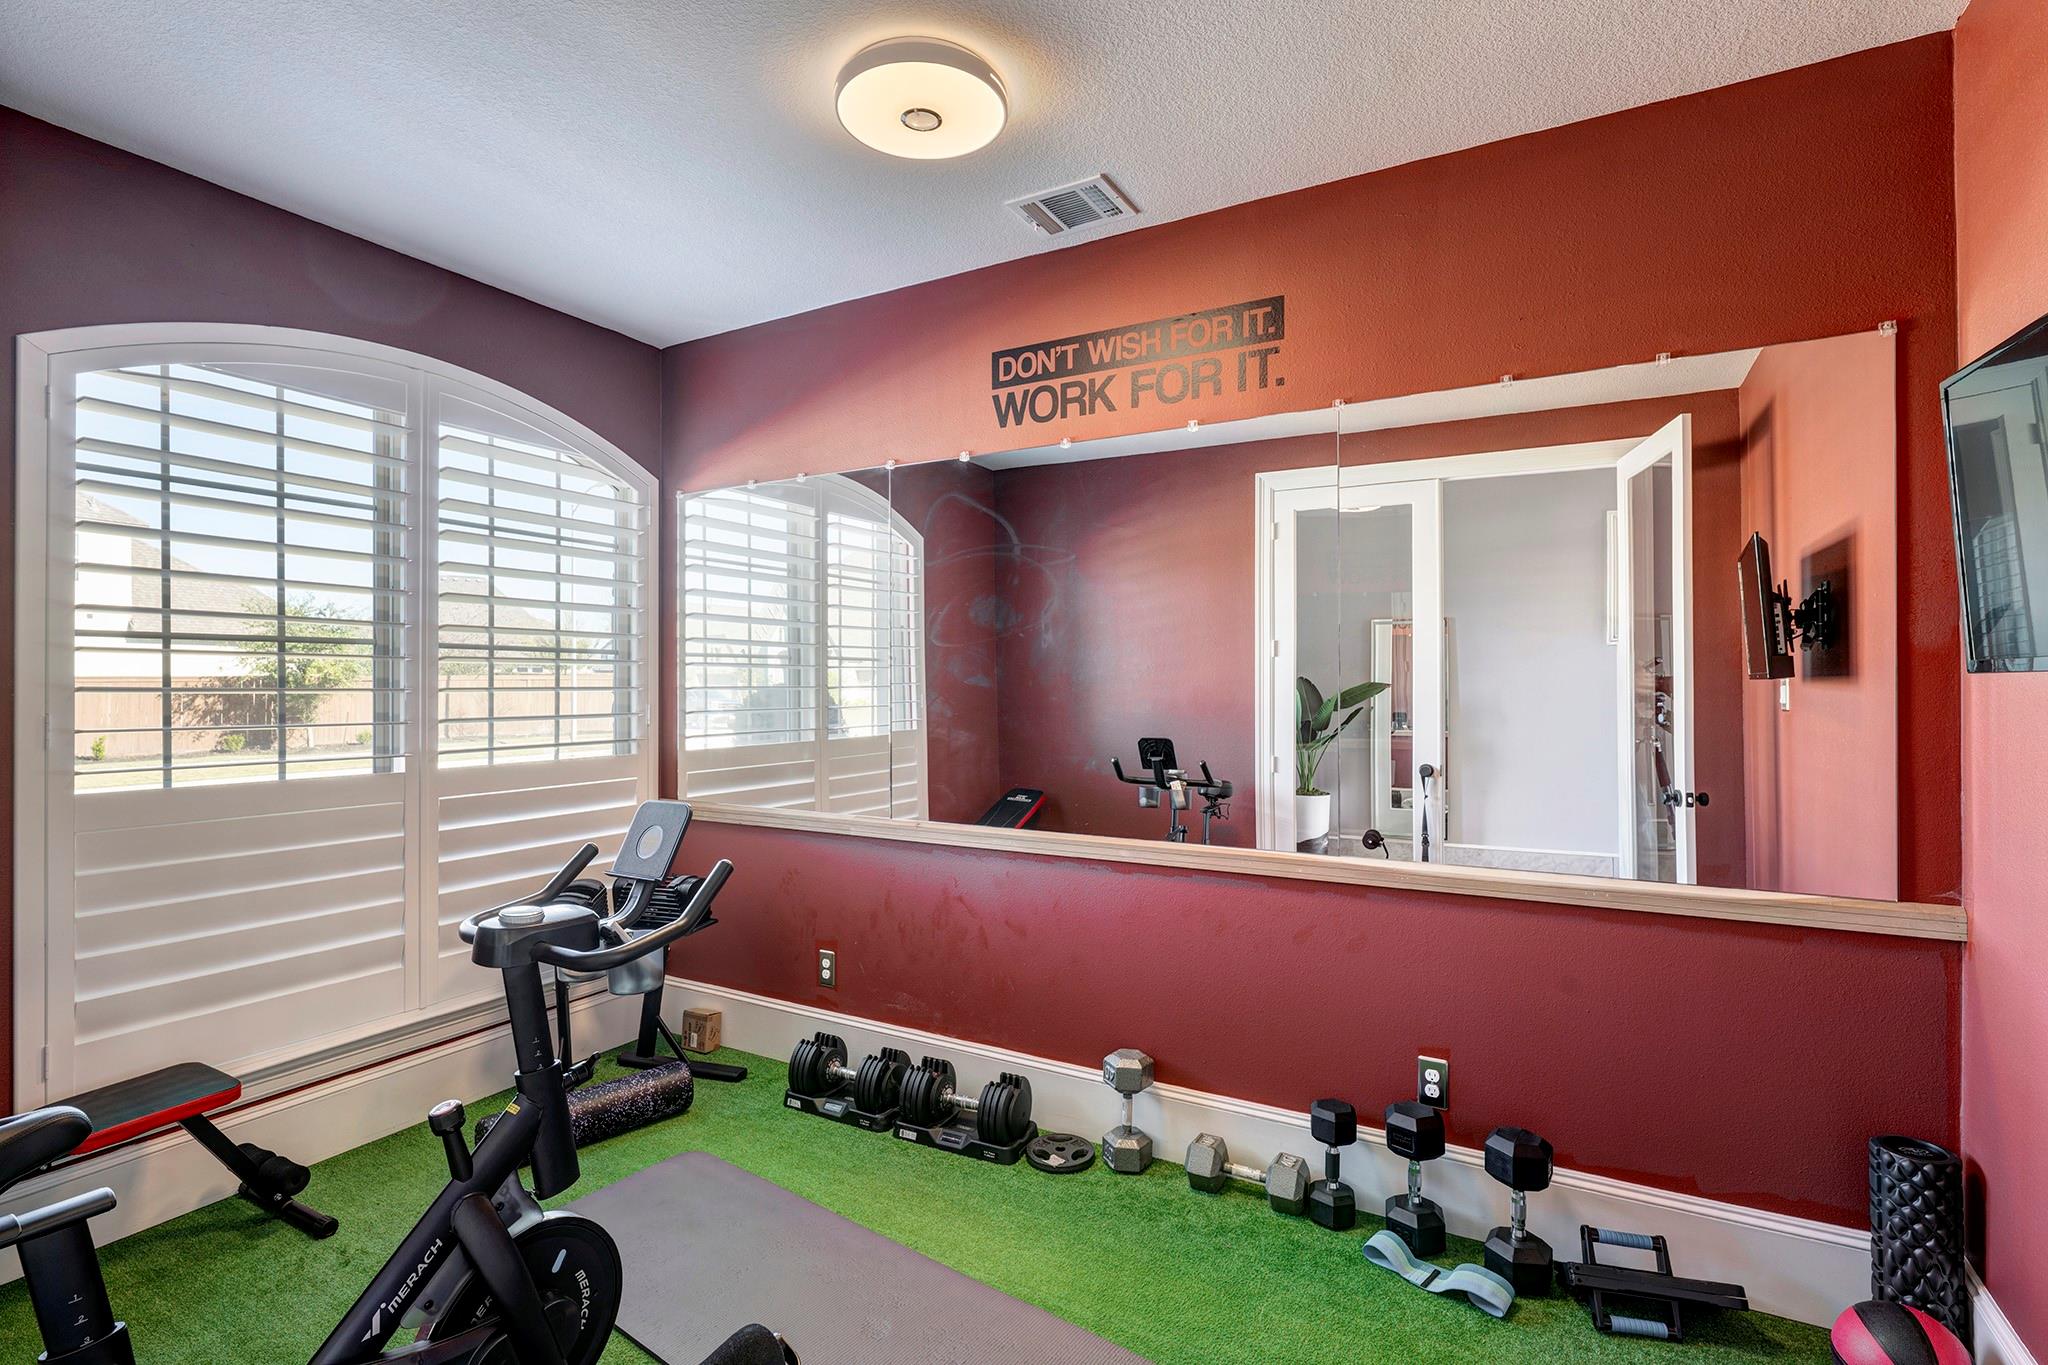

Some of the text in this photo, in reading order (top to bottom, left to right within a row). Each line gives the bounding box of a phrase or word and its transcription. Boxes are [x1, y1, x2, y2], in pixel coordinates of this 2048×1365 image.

[999, 306, 1276, 382] DON'T WISH FOR IT.
[992, 346, 1286, 428] WORK FOR IT.
[387, 1238, 443, 1314] MERACH
